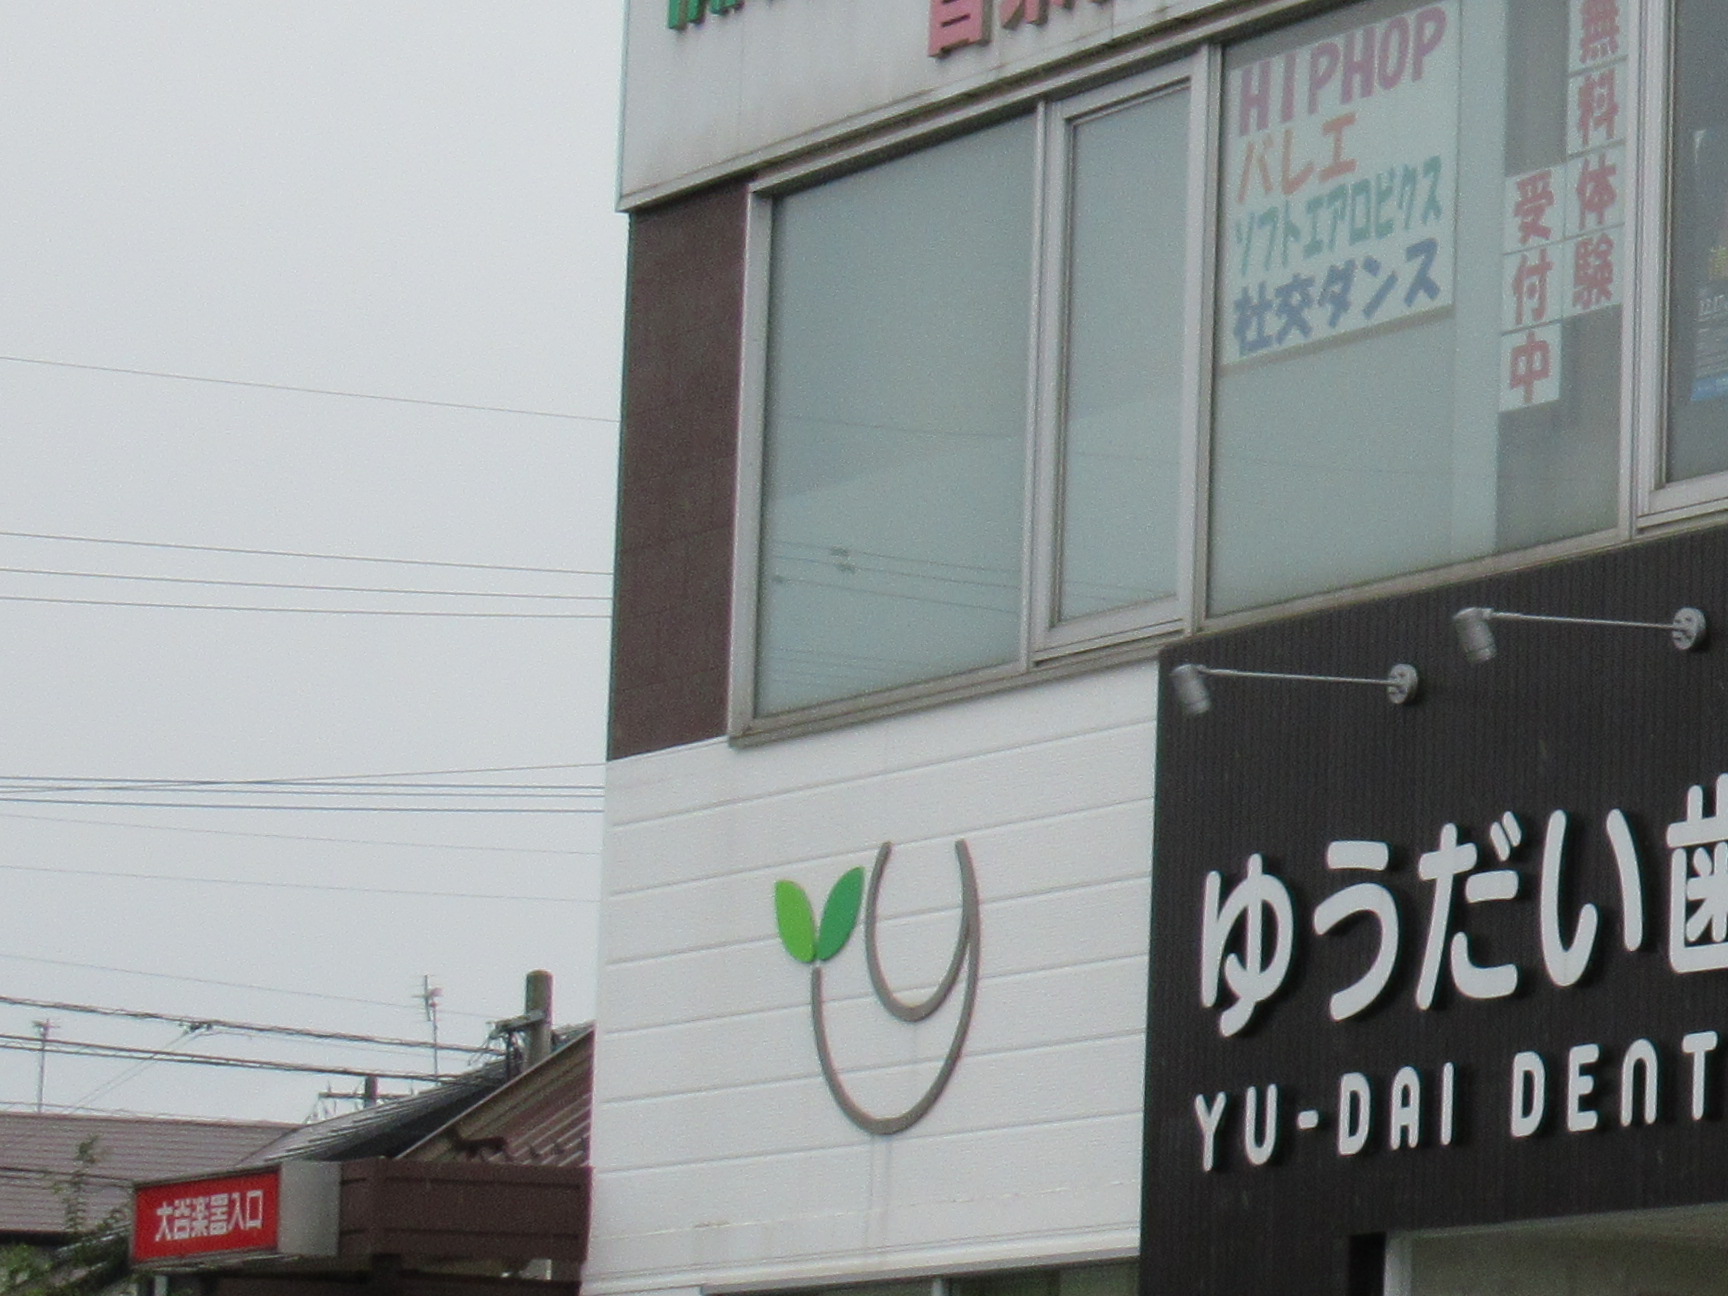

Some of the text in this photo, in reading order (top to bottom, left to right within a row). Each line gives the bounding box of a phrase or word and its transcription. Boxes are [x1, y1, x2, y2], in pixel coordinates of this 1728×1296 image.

[1239, 6, 1447, 137] HIPHOP
[1237, 110, 1358, 203] バレエ
[1232, 237, 1440, 356] 社交ダンス
[1509, 170, 1555, 403] 受付中
[1195, 1062, 1455, 1171] YU-DAI
